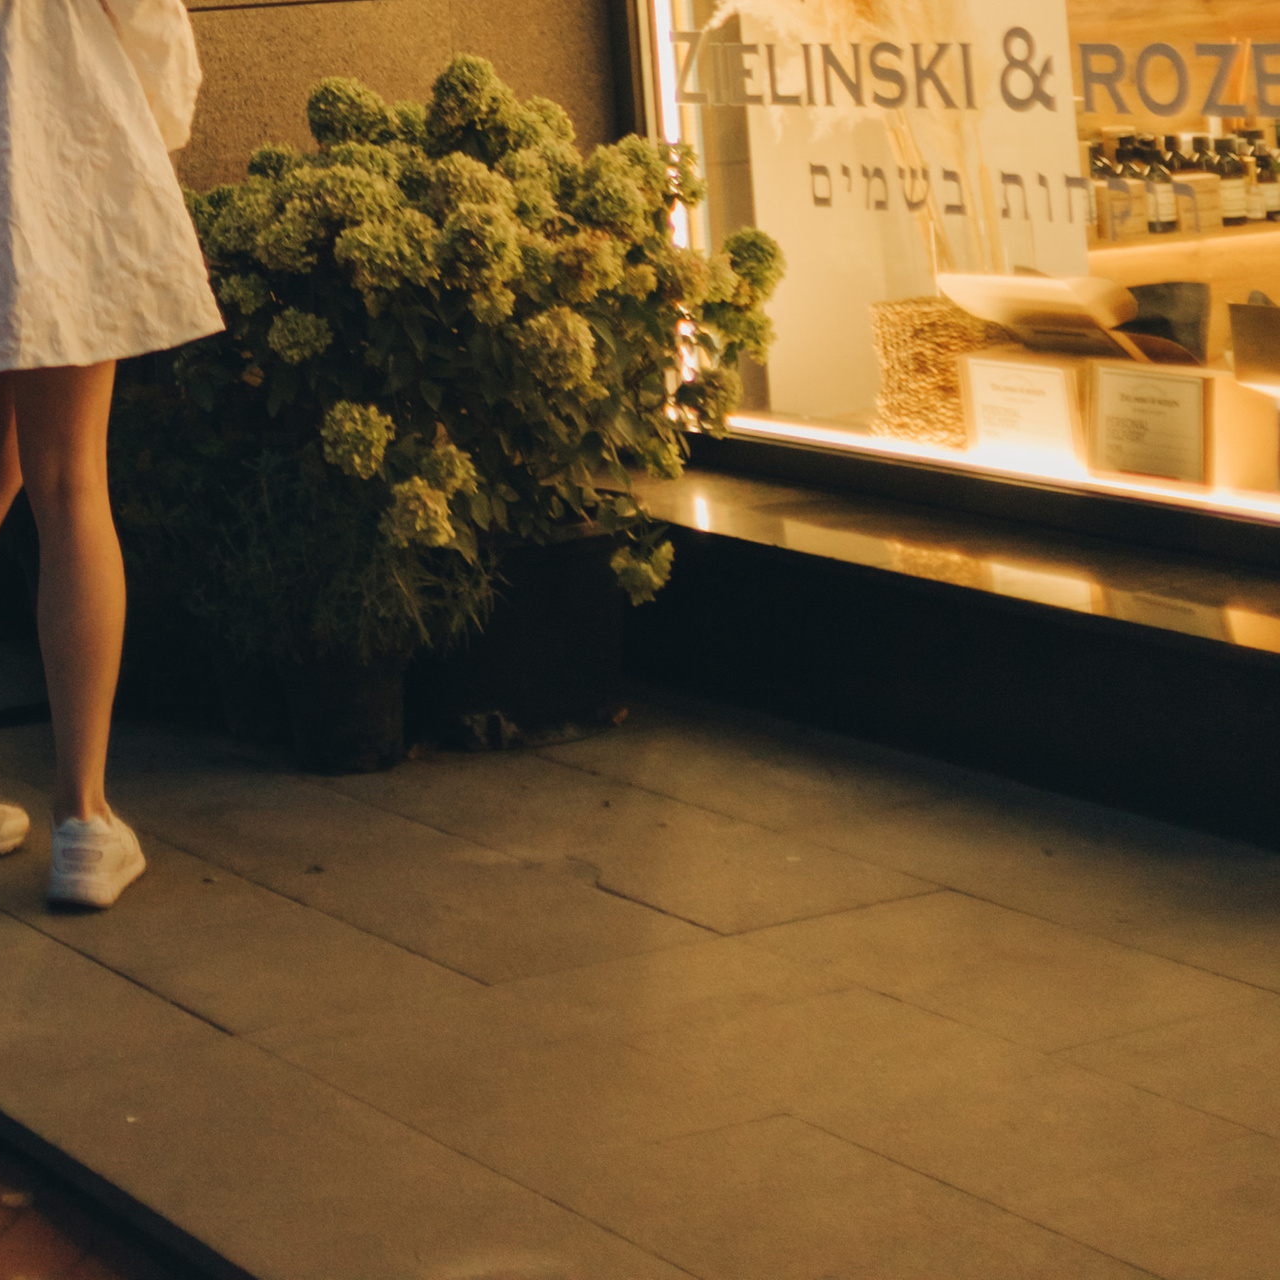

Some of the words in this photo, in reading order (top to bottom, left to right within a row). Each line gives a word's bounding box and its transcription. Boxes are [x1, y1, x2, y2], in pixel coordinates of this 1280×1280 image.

[670, 30, 979, 111] ZIELINSKI
[1000, 26, 1057, 112] &
[808, 161, 967, 216] בשמים
